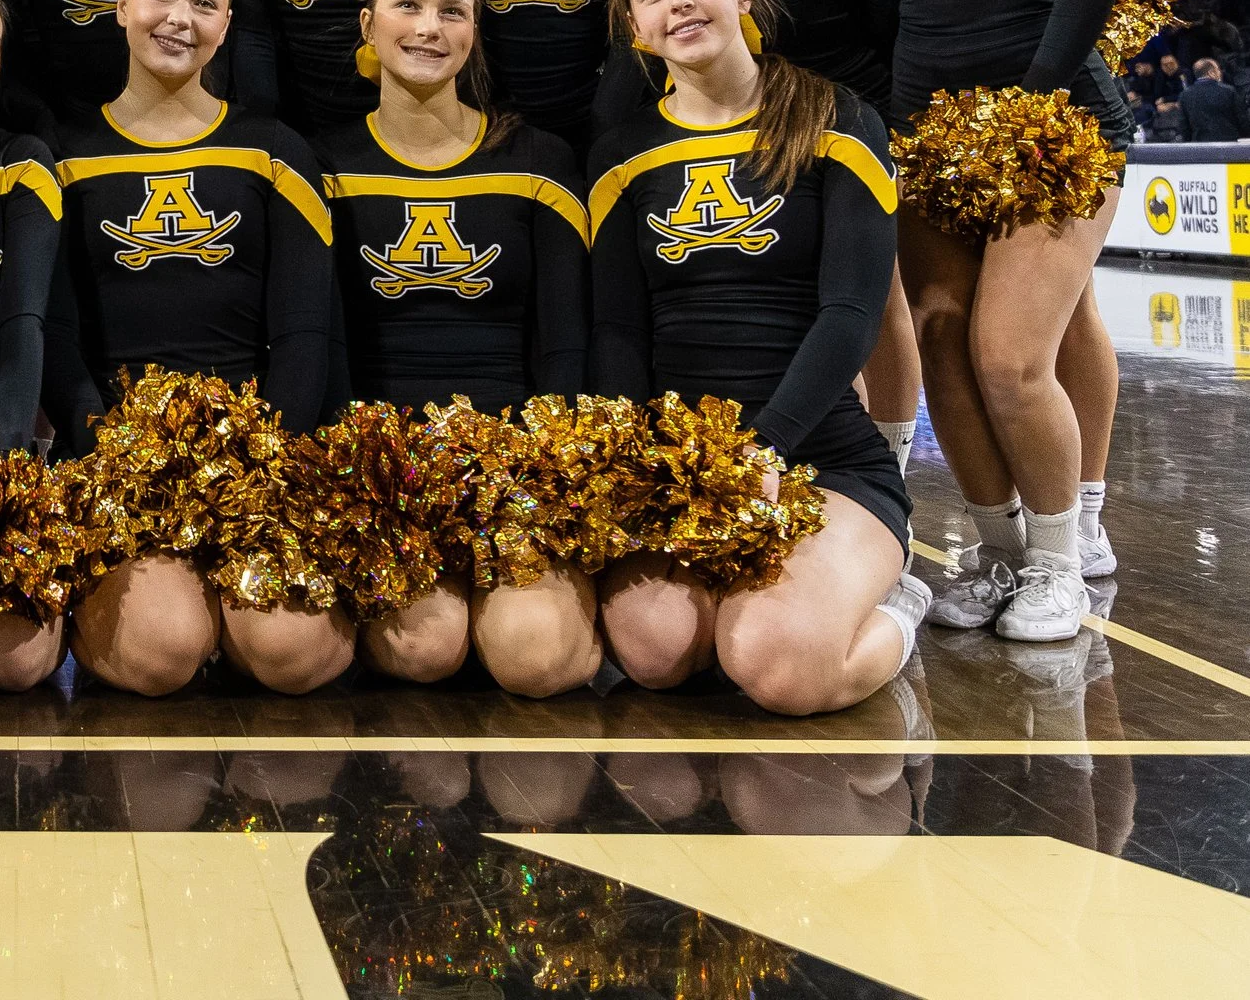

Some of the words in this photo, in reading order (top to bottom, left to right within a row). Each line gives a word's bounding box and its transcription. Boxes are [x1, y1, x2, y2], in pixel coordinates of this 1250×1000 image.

[128, 171, 215, 236] A
[668, 159, 754, 230] A
[1179, 180, 1217, 193] BUFFALO
[1180, 195, 1218, 216] WILD
[385, 202, 475, 267] A
[1181, 217, 1219, 234] WINGS
